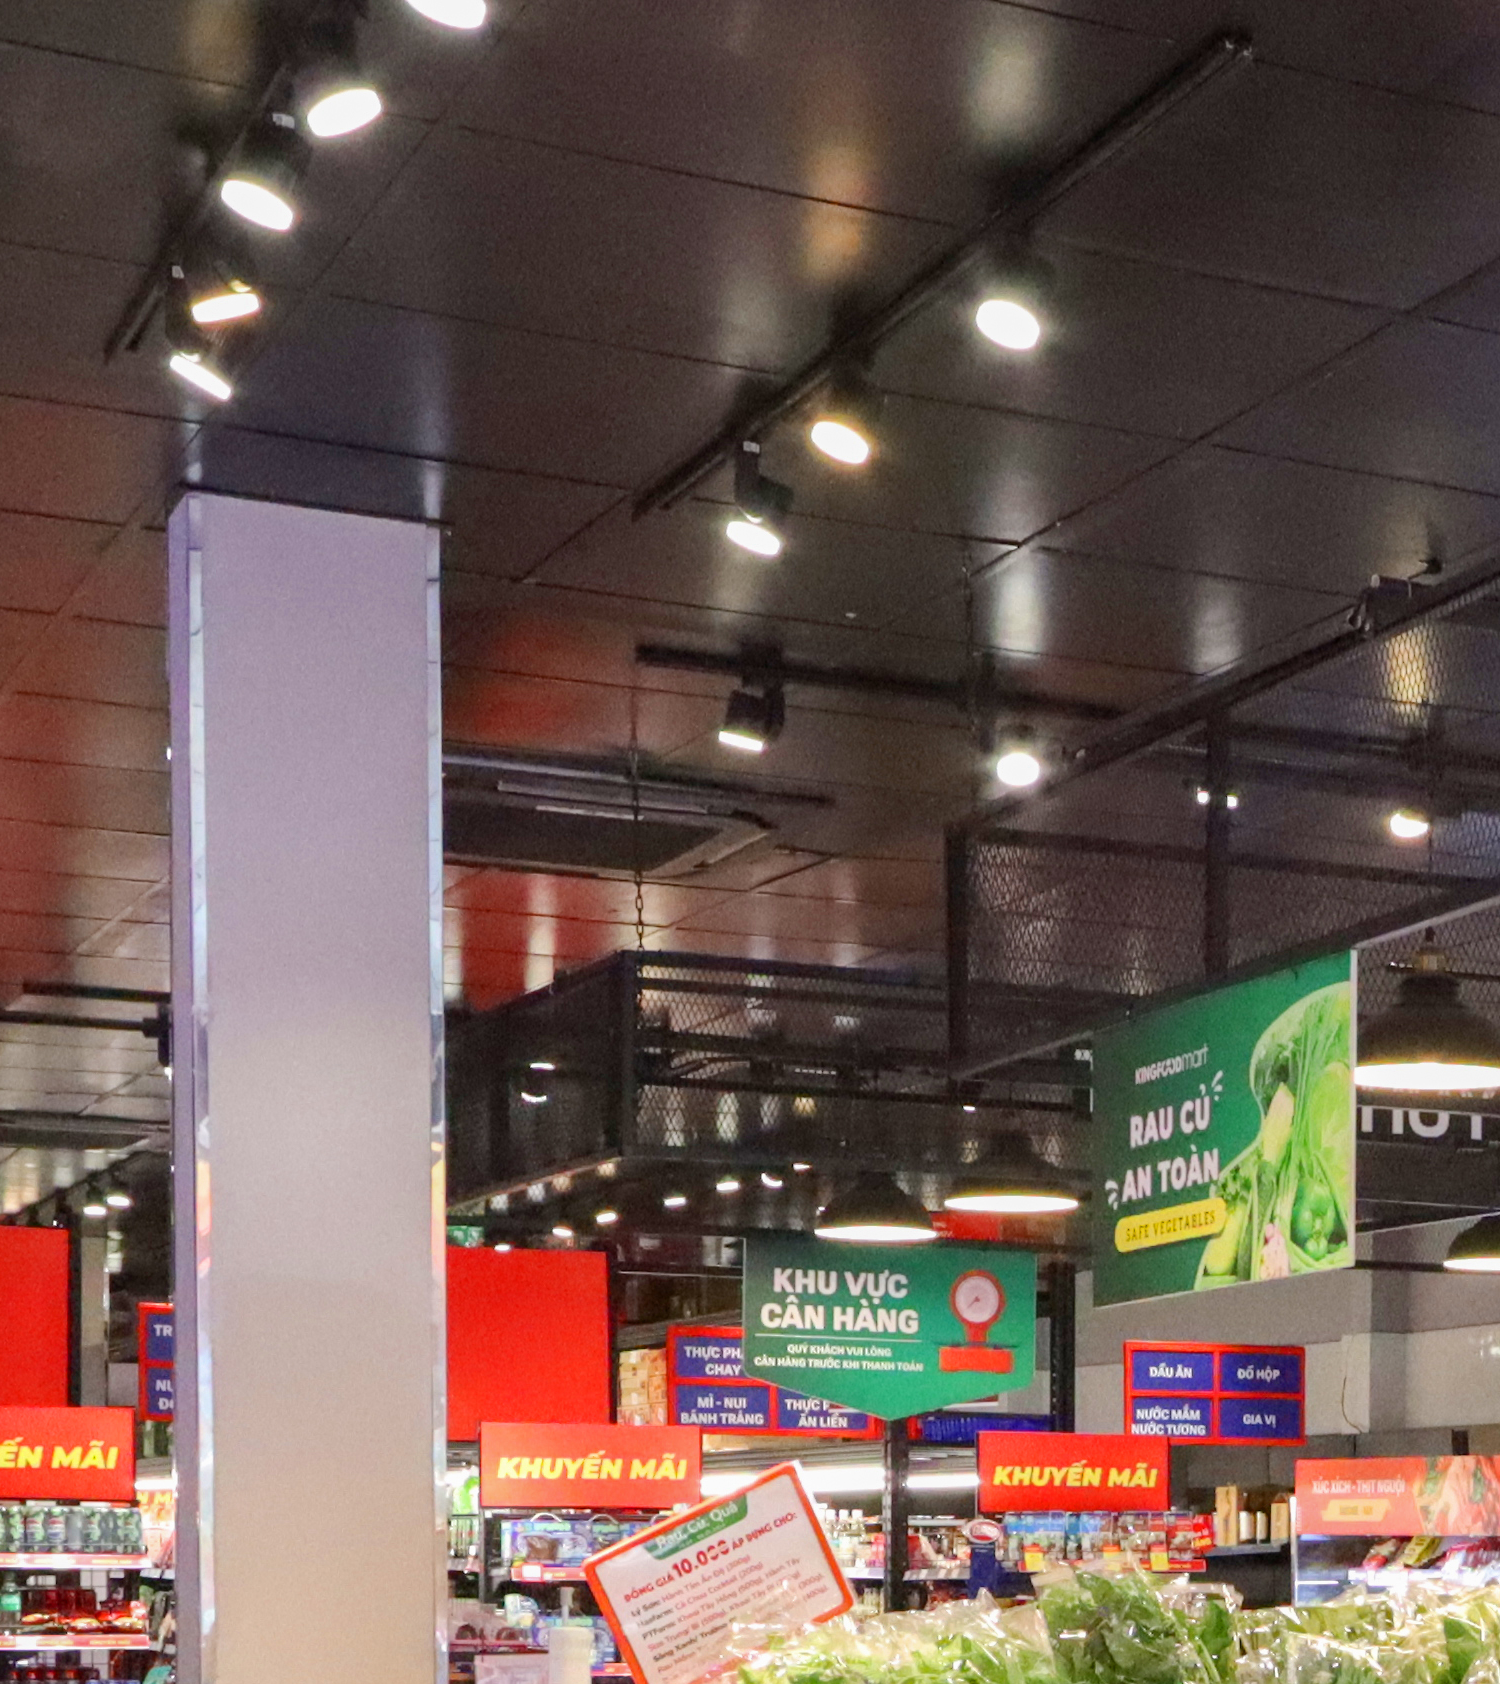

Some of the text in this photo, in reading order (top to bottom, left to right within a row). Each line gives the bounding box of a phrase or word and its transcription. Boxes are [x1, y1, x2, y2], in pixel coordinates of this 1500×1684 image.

[1130, 1083, 1210, 1149] RAU CỦ
[1121, 1144, 1220, 1203] AN TOÀN
[1126, 1210, 1216, 1242] SAFE VEGETABLES
[773, 1267, 909, 1304] KHU VỰC
[760, 1295, 920, 1334] CÂN HÀNG
[684, 1344, 721, 1362] THỰC
[705, 1362, 741, 1377] CHAY
[680, 1408, 764, 1426] BÁNH TRÁNG
[724, 1397, 747, 1410] NUI
[1243, 1413, 1262, 1426] GIA
[51, 1440, 119, 1470] MÃI
[497, 1450, 687, 1480] KHUYẾN MÃI
[993, 1460, 1158, 1488] KHUYẾN MÃI
